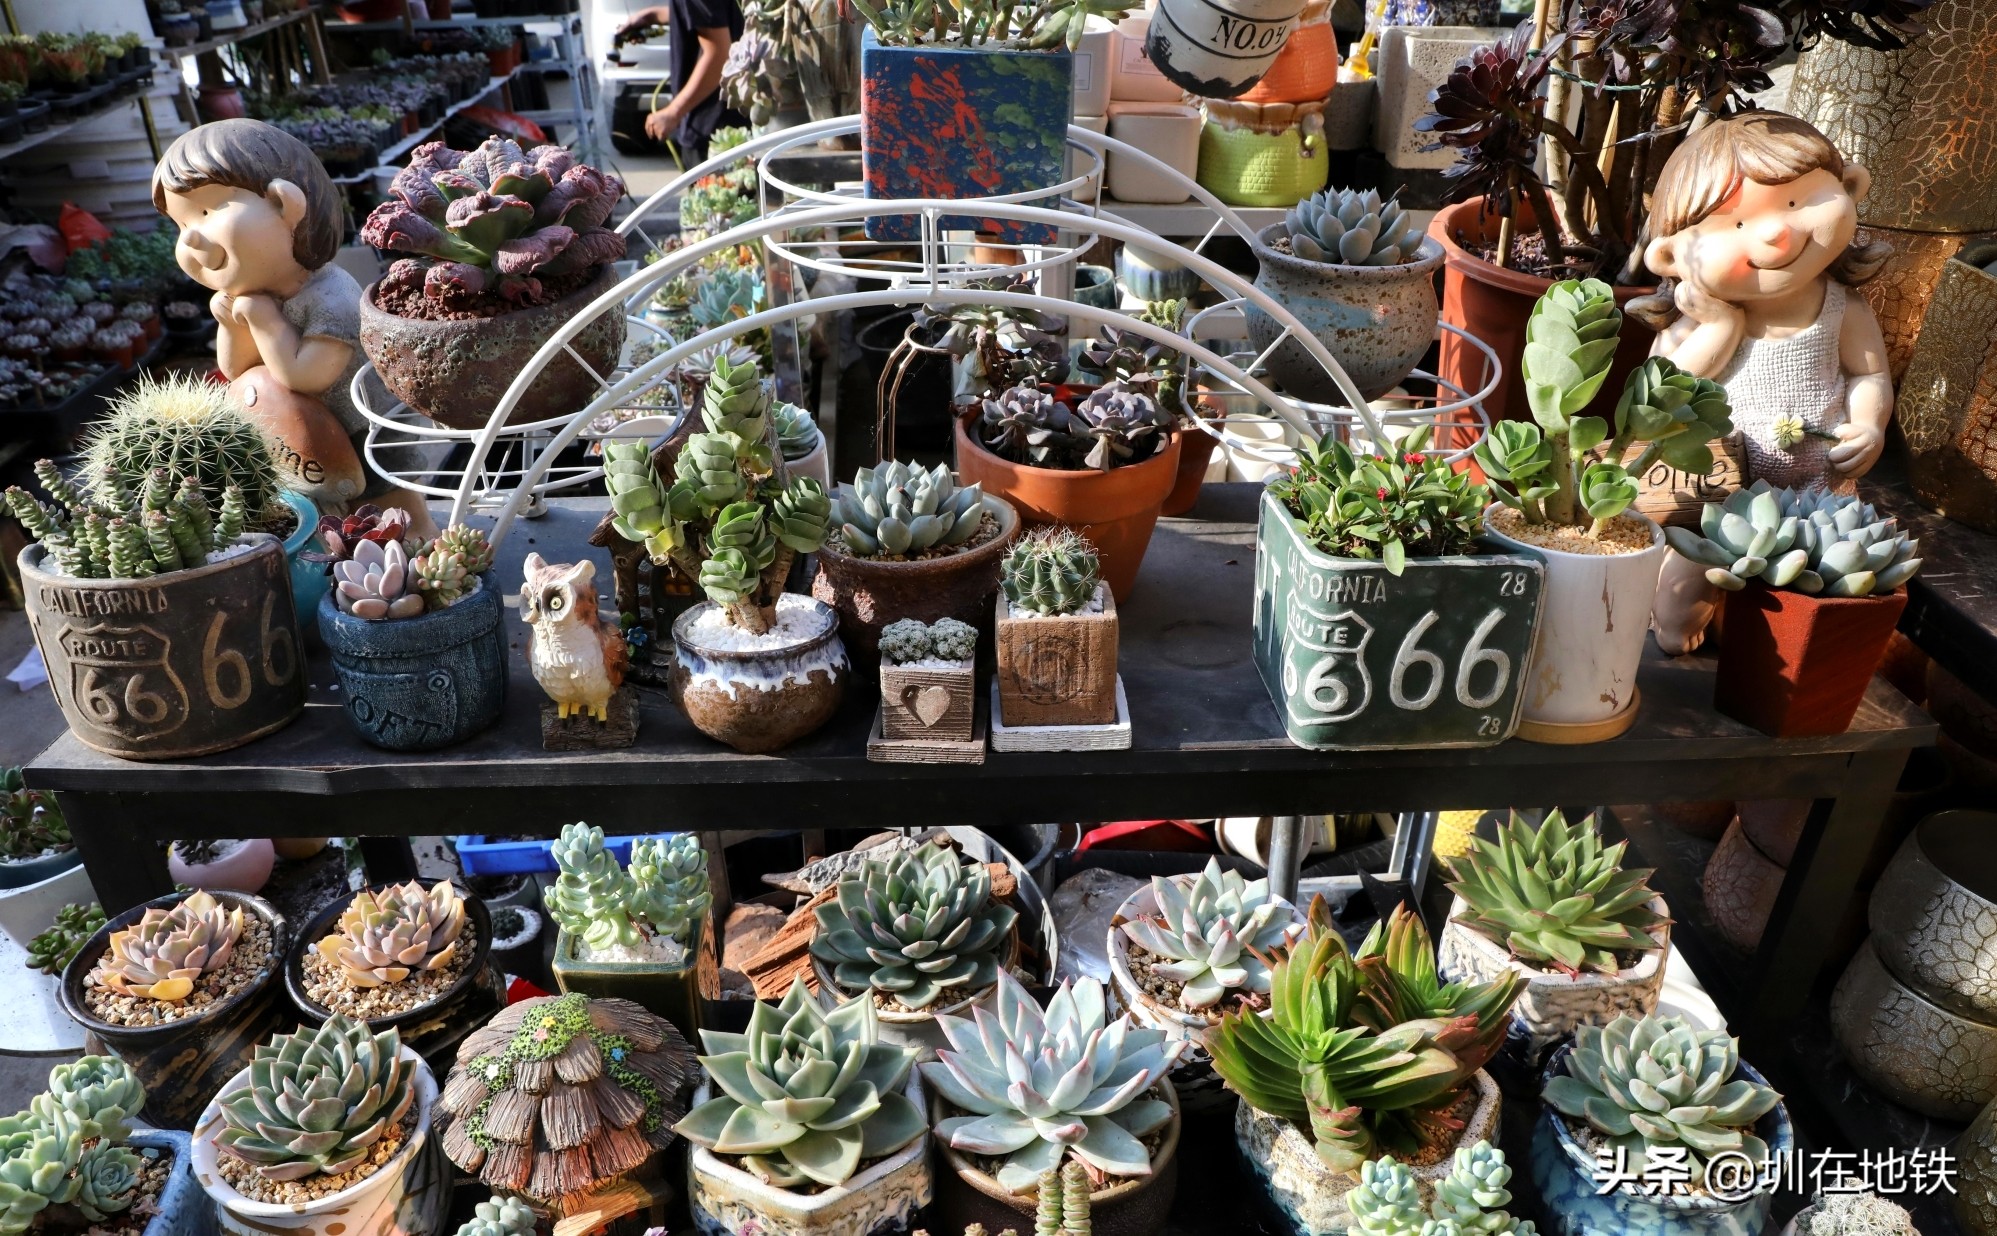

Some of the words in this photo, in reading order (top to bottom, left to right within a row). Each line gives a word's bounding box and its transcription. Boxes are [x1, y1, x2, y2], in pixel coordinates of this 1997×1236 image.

[1210, 15, 1287, 50] NO.04
[1287, 545, 1387, 603] CALIFORNIA
[1500, 571, 1528, 597] 28
[39, 585, 168, 618] CALIFORNIA
[1290, 604, 1349, 645] ROUTE
[71, 639, 147, 657] ROUTE
[203, 589, 297, 709] 66
[1389, 607, 1511, 711] 66
[82, 669, 168, 724] 66
[1283, 640, 1349, 713] 66
[1477, 715, 1500, 737] 28
